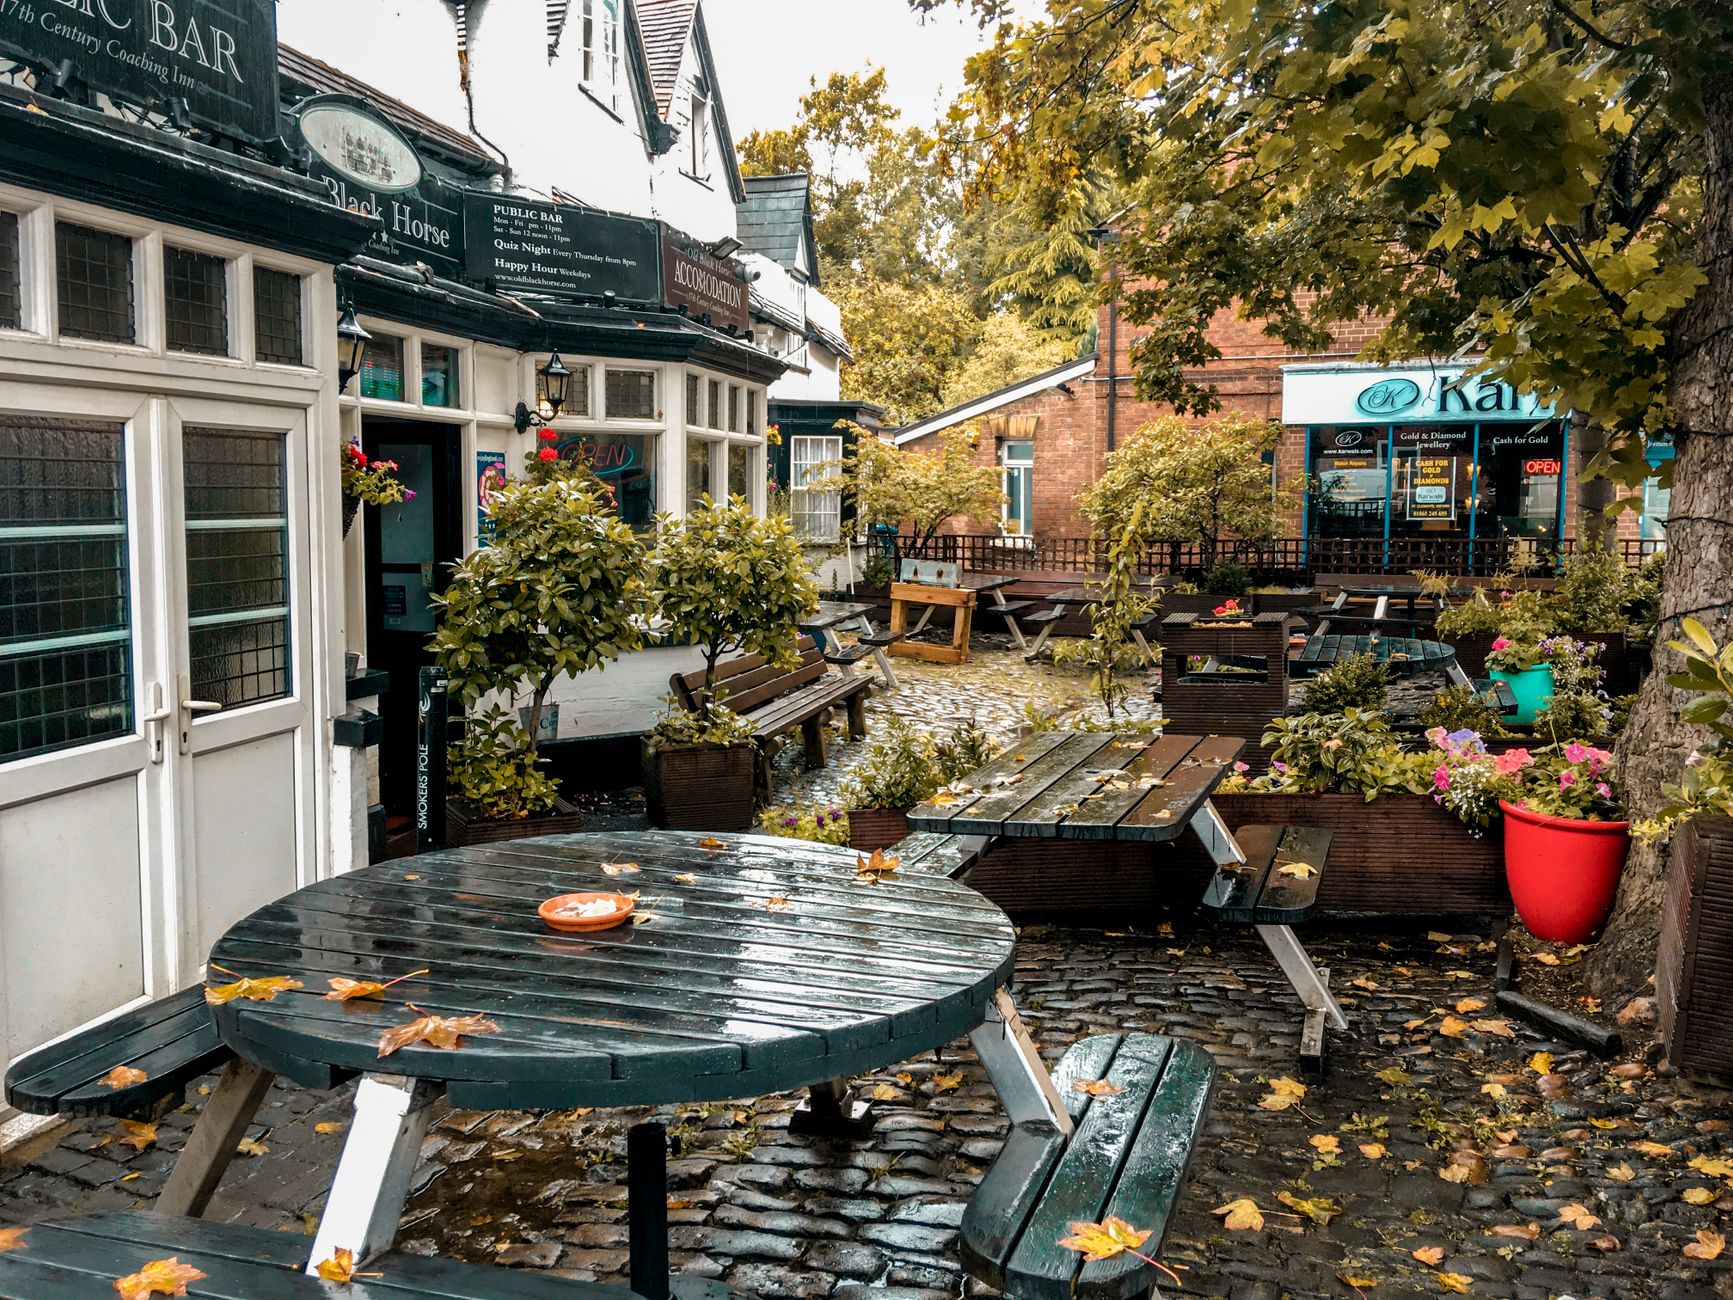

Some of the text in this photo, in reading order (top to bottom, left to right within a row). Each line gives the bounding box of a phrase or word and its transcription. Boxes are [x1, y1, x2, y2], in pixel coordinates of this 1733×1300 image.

[40, 12, 101, 54] Century
[106, 39, 169, 84] Coaching
[172, 65, 195, 89] Inn
[149, 1, 244, 84] BAR
[321, 174, 450, 248] Black Horse
[493, 204, 564, 224] PUBLIC BAR
[493, 216, 509, 225] Mon
[514, 219, 524, 227] Fri
[528, 222, 539, 230] pm
[544, 224, 562, 233] 11pm
[493, 225, 504, 233] Sat
[509, 227, 522, 235] Sun
[523, 229, 531, 237] 12
[553, 234, 571, 243] 11pm
[493, 238, 637, 267] Quiz Night Every Thursday from 8pm
[494, 257, 592, 279] Happy Hour Weekdays
[715, 261, 730, 277] Horse
[494, 273, 577, 289] www.oldblackhorse.com
[674, 259, 742, 310] ACCOMODATION
[1400, 431, 1467, 440] Gold & Diamond
[1415, 441, 1451, 450] Jewellery
[1492, 435, 1549, 444] Cash for Gold
[561, 443, 627, 466] OPEN
[1526, 461, 1561, 474] OPEN
[419, 743, 429, 772] POLE
